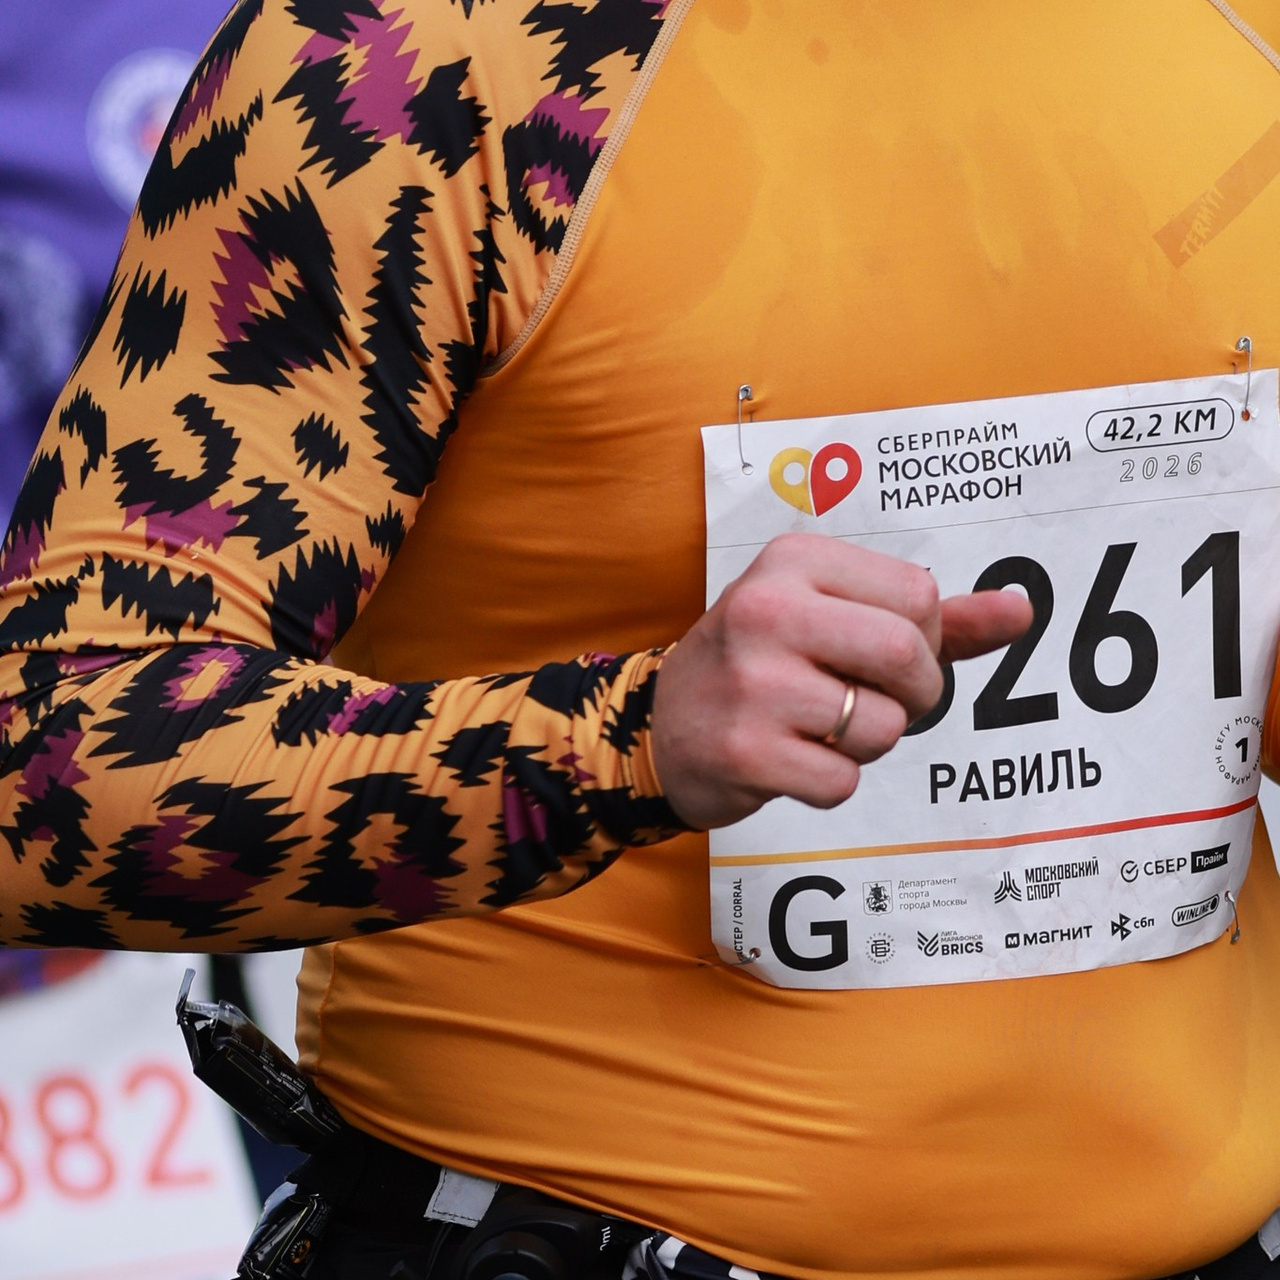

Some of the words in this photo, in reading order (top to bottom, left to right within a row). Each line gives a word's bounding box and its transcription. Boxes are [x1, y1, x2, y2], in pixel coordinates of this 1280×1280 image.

[877, 421, 1019, 455] СБЕРПРАЙМ
[1103, 413, 1163, 443] 42,2
[1173, 407, 1217, 436] КМ
[879, 436, 1072, 484] МОСКОВСКИЙ
[1119, 451, 1203, 483] 2026
[880, 474, 1023, 512] МАРАФОН
[898, 531, 1242, 737] 261
[1214, 723, 1231, 751] БЕГУ
[1234, 736, 1249, 763] 1
[929, 747, 1103, 805] РАВИЛЬ
[1025, 856, 1100, 884] МОСКОВСКИЙ
[1143, 857, 1187, 877] СБЕР
[1195, 851, 1225, 869] Прайм
[898, 877, 958, 890] Департамент
[898, 890, 930, 900] спорта
[1026, 882, 1062, 902] СПОРТ
[732, 878, 743, 919] CORRAL
[899, 901, 931, 912] города
[932, 899, 968, 908] Москвы
[1176, 900, 1212, 923] WINLINE
[768, 875, 849, 972] G
[1133, 916, 1155, 929] сбп
[941, 941, 984, 956] BRICS
